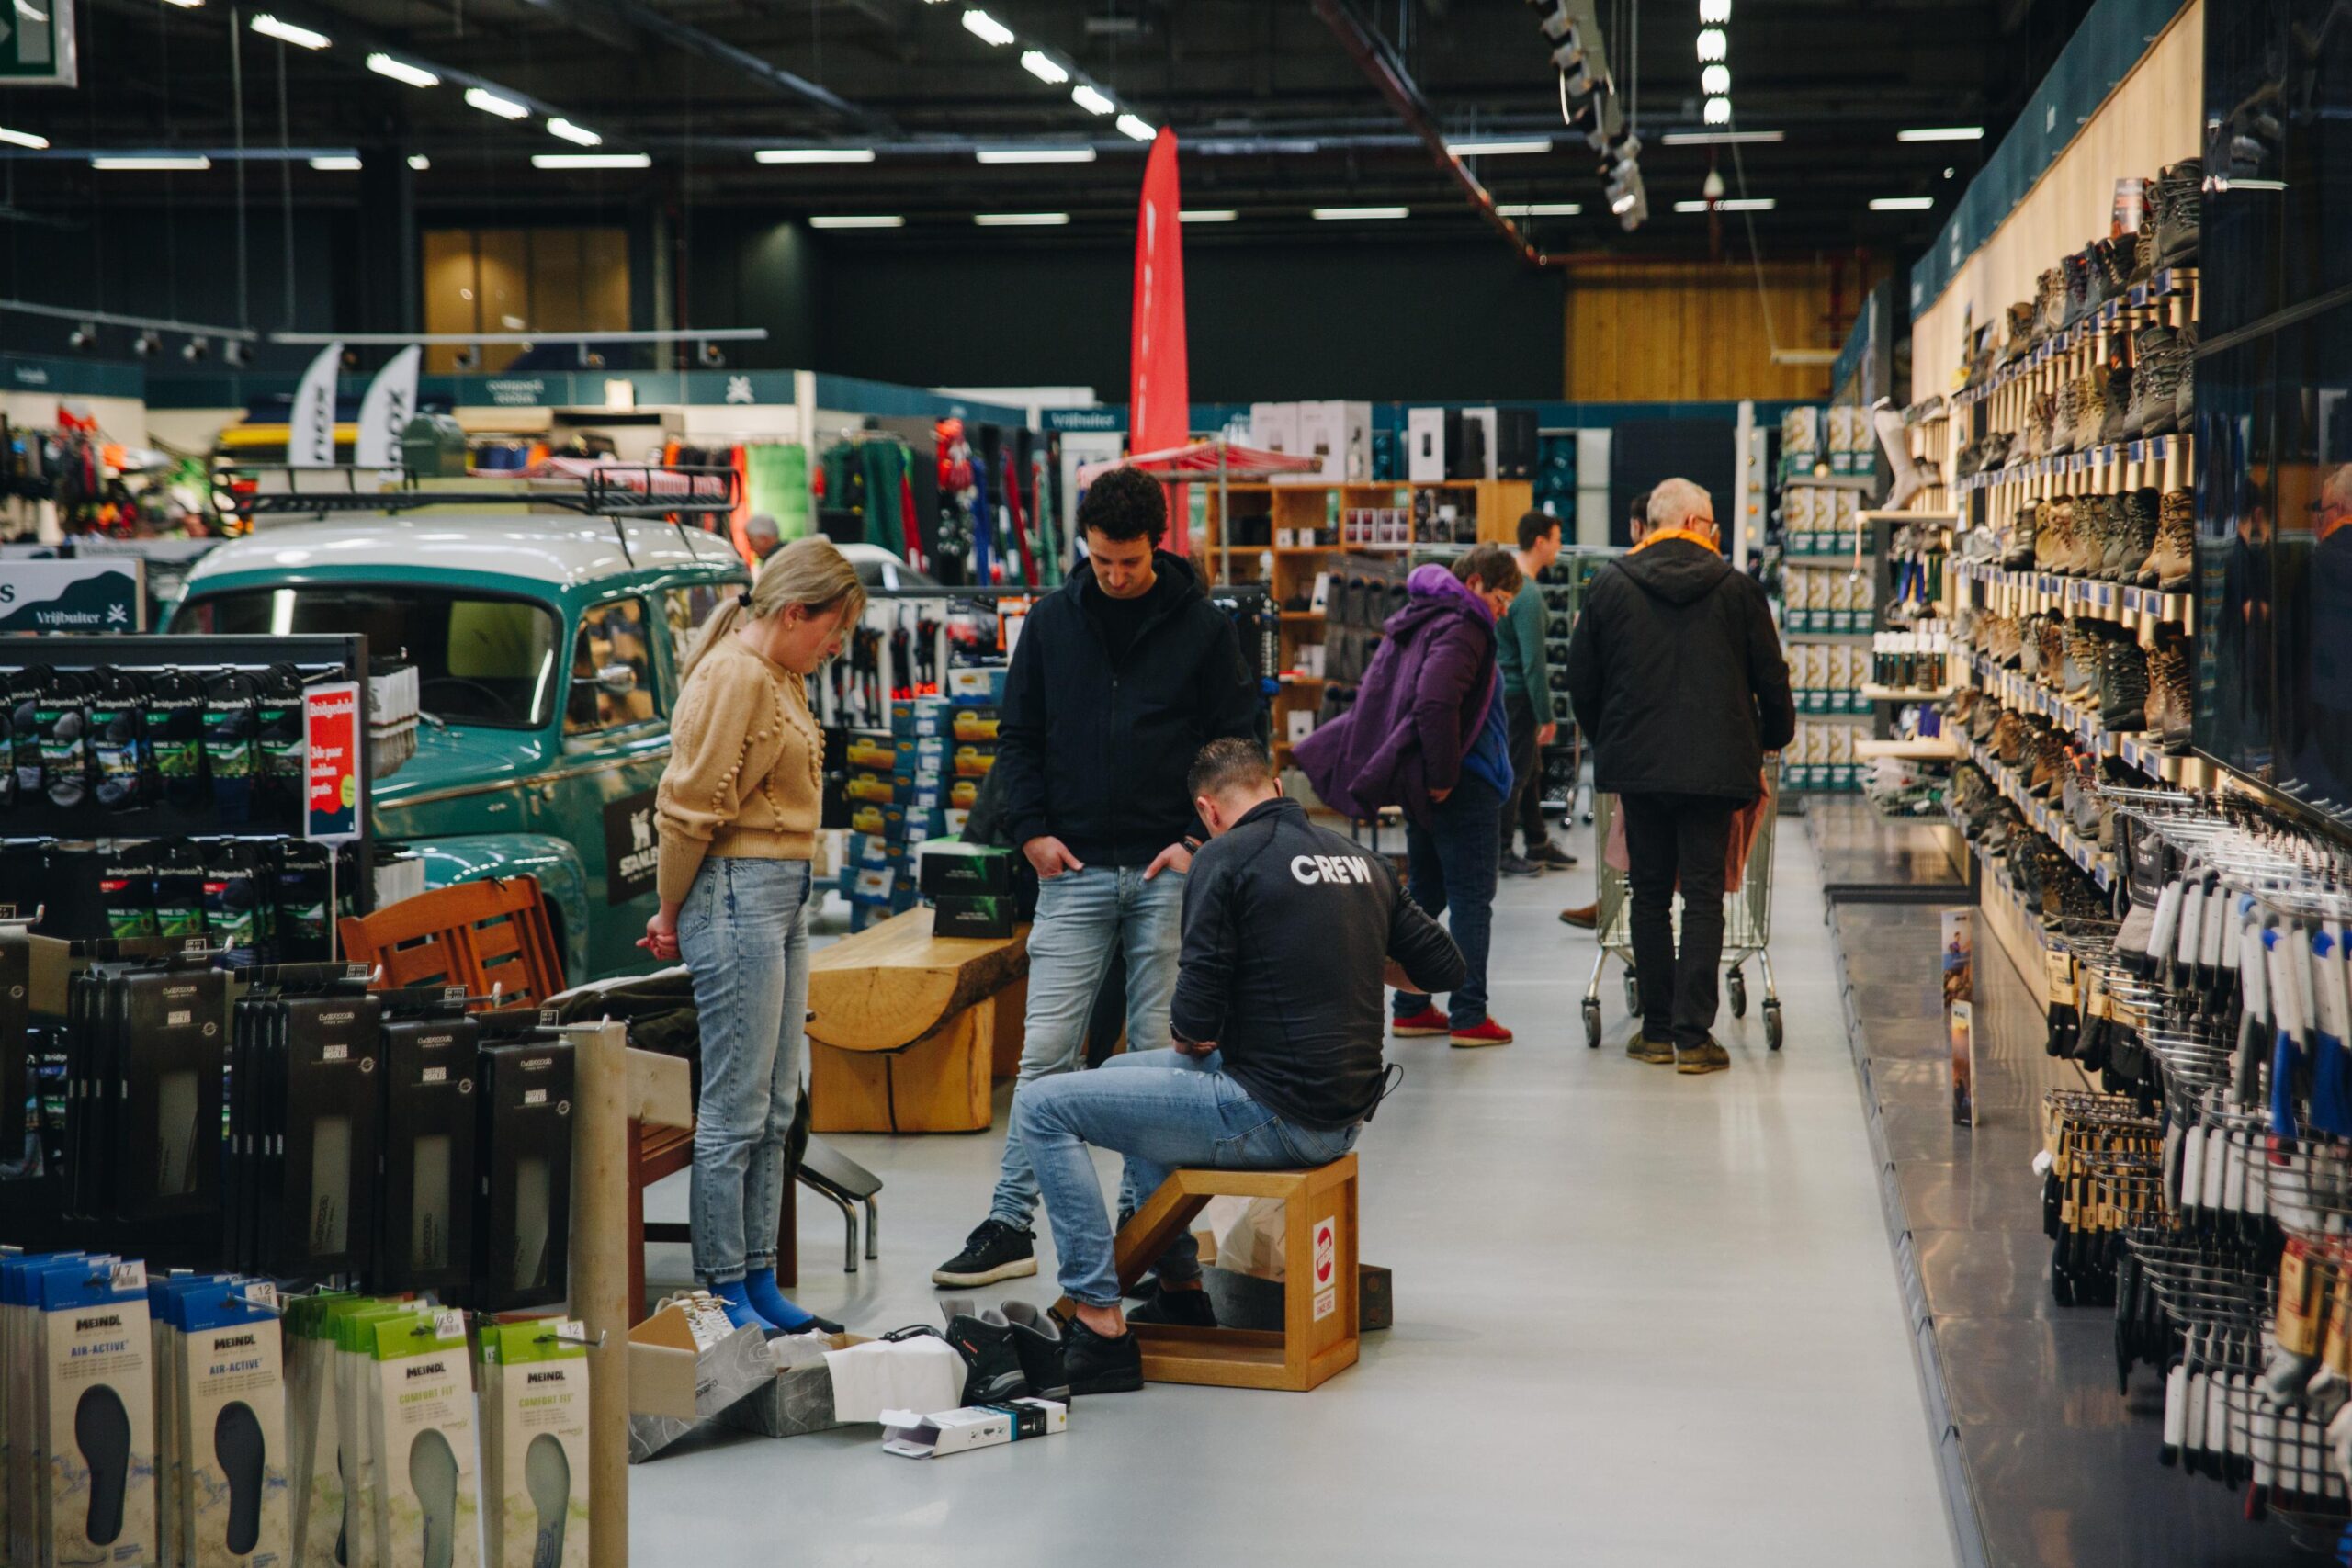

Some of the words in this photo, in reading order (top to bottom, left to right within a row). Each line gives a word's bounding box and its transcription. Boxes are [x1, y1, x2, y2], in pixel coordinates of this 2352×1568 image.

[36, 610, 101, 626] Vrijbuiter
[40, 697, 83, 707] Bridgedale
[96, 699, 136, 709] Bridgedale
[208, 699, 251, 710] Bridgedale
[310, 698, 354, 719] Bridgedale
[311, 763, 337, 778] sokken
[311, 783, 333, 799] gratis
[106, 866, 153, 876] Bridgedale
[209, 869, 253, 880] Bridgedale
[1291, 854, 1372, 885] CREW
[125, 1265, 132, 1276] 7
[258, 1284, 272, 1296] 12
[76, 1314, 122, 1332] MEINDL
[446, 1312, 454, 1324] 6
[568, 1324, 579, 1335] 12
[214, 1334, 256, 1351] MEINDL
[406, 1361, 447, 1379] MEINDL
[527, 1370, 566, 1384] MEINDL
[399, 1388, 438, 1404] COMFORT
[518, 1396, 557, 1408] COMFORT
